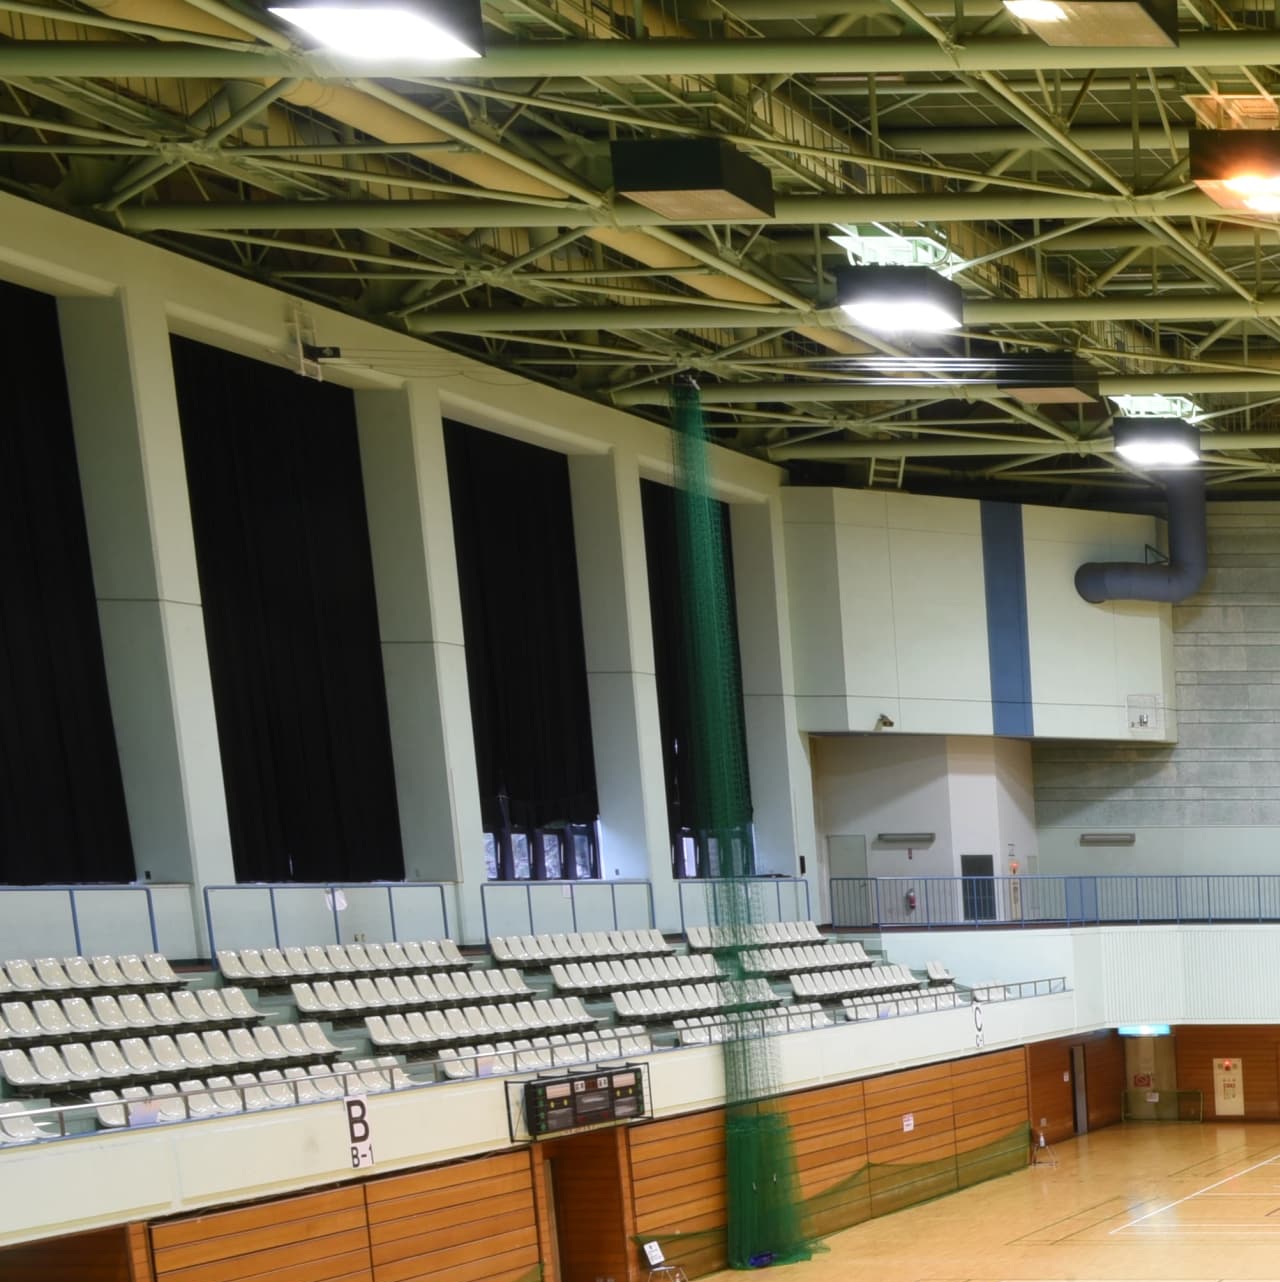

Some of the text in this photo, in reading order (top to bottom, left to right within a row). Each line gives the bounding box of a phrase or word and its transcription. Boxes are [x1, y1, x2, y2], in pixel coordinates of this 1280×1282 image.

[975, 1006, 983, 1032] C
[346, 1100, 370, 1144] B
[351, 1144, 374, 1168] B-1
